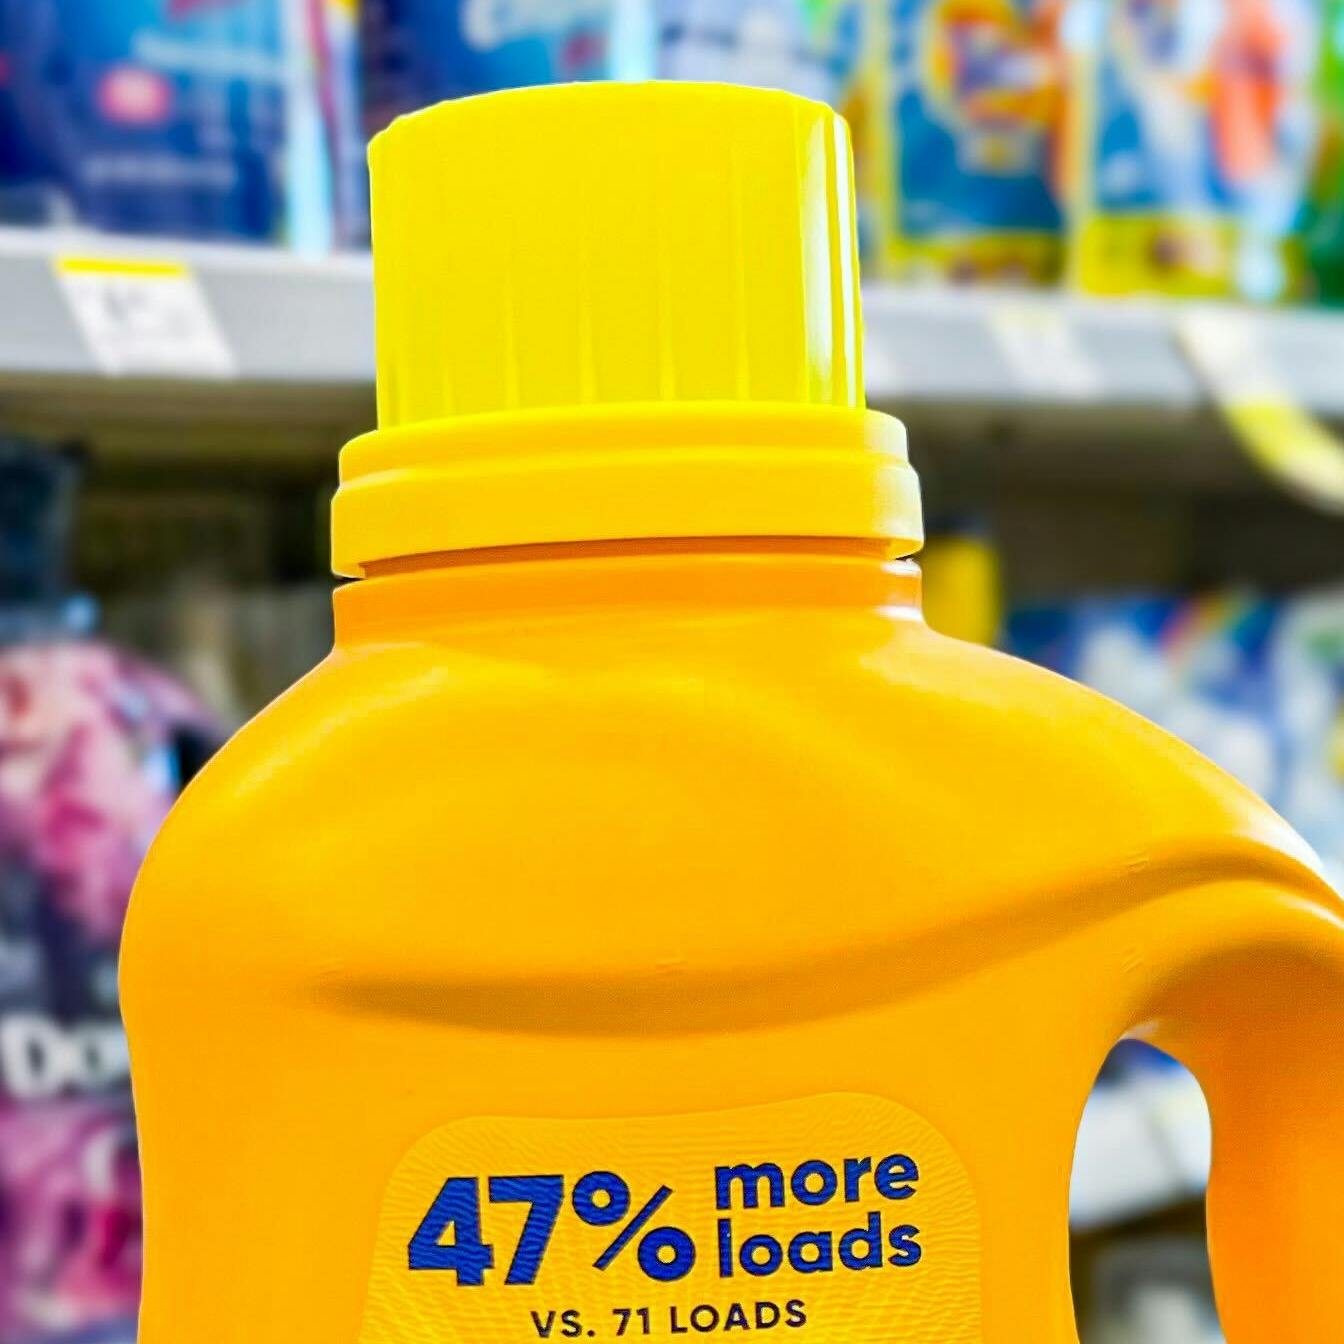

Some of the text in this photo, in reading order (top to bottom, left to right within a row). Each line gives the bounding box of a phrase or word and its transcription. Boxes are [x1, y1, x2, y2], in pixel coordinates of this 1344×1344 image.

[715, 1153, 919, 1210] more
[408, 1170, 696, 1287] 47%
[718, 1210, 923, 1278] loads
[531, 1298, 808, 1339] VS. 71 LOADS
